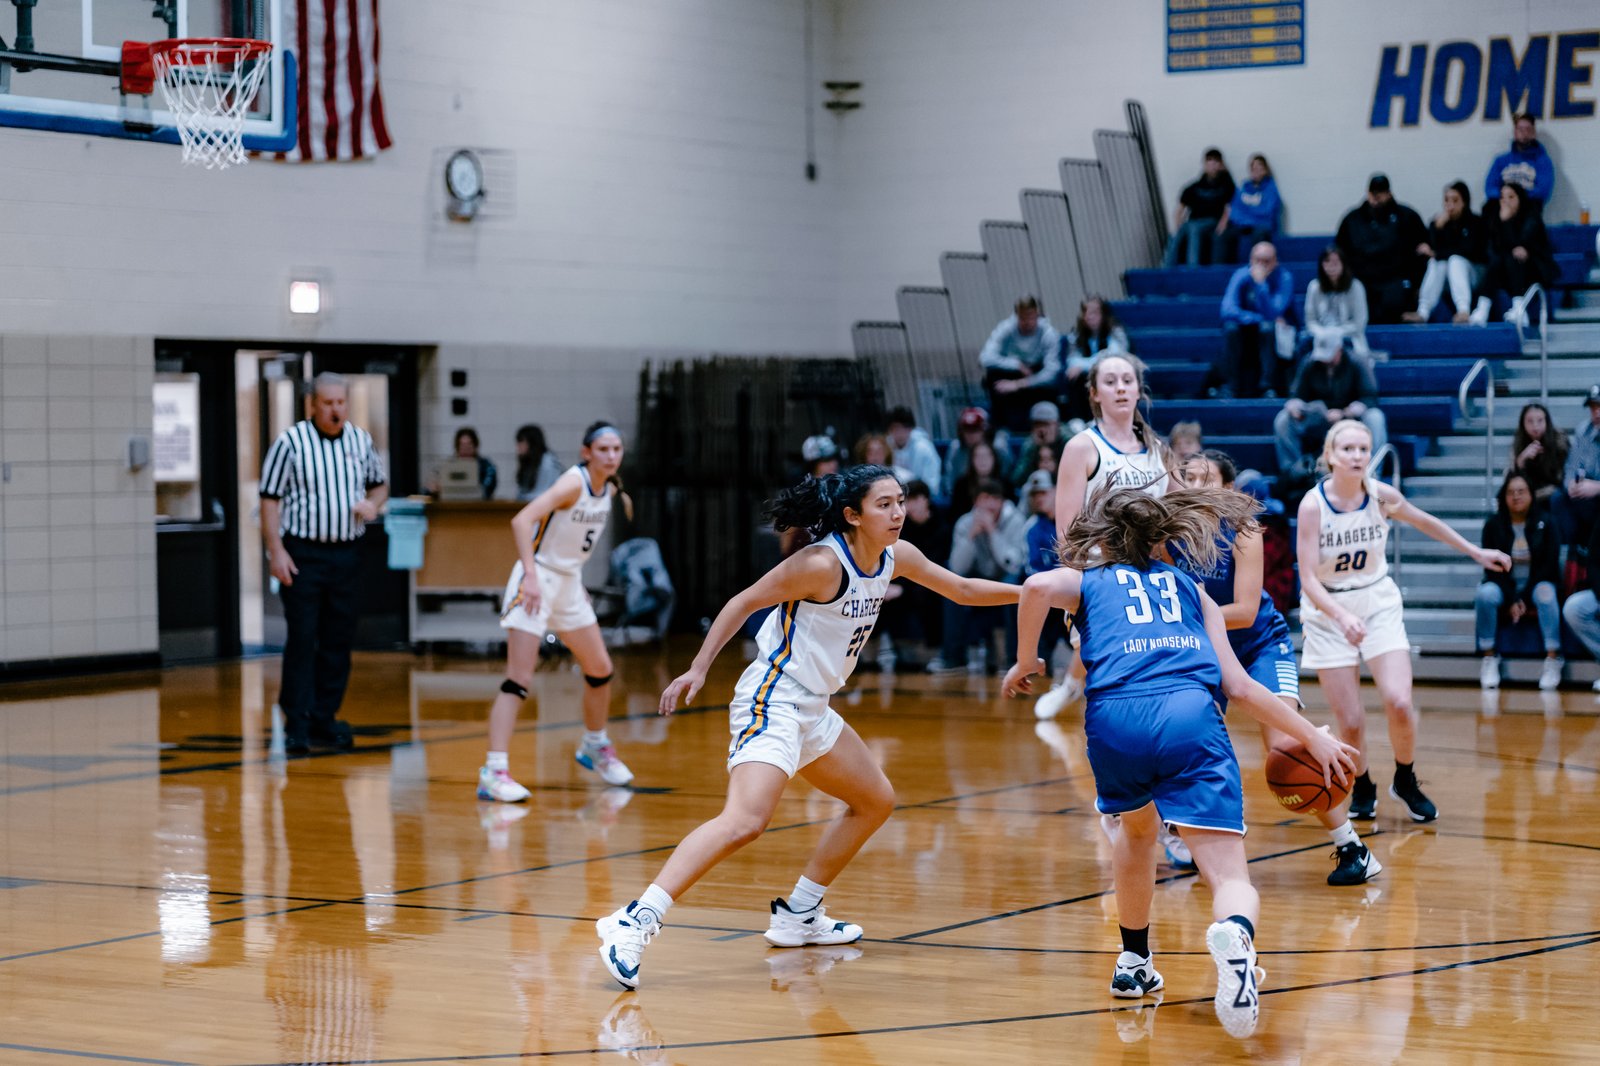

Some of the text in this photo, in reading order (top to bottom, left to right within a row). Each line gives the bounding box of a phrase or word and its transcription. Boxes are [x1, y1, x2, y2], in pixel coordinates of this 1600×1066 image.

[1369, 30, 1600, 128] HOME
[581, 529, 595, 552] 5
[1319, 524, 1383, 549] CHARGERS
[1335, 550, 1367, 572] 20
[1115, 568, 1183, 625] 33
[845, 624, 873, 657] 25
[1123, 635, 1201, 654] LADY NORSEMEN
